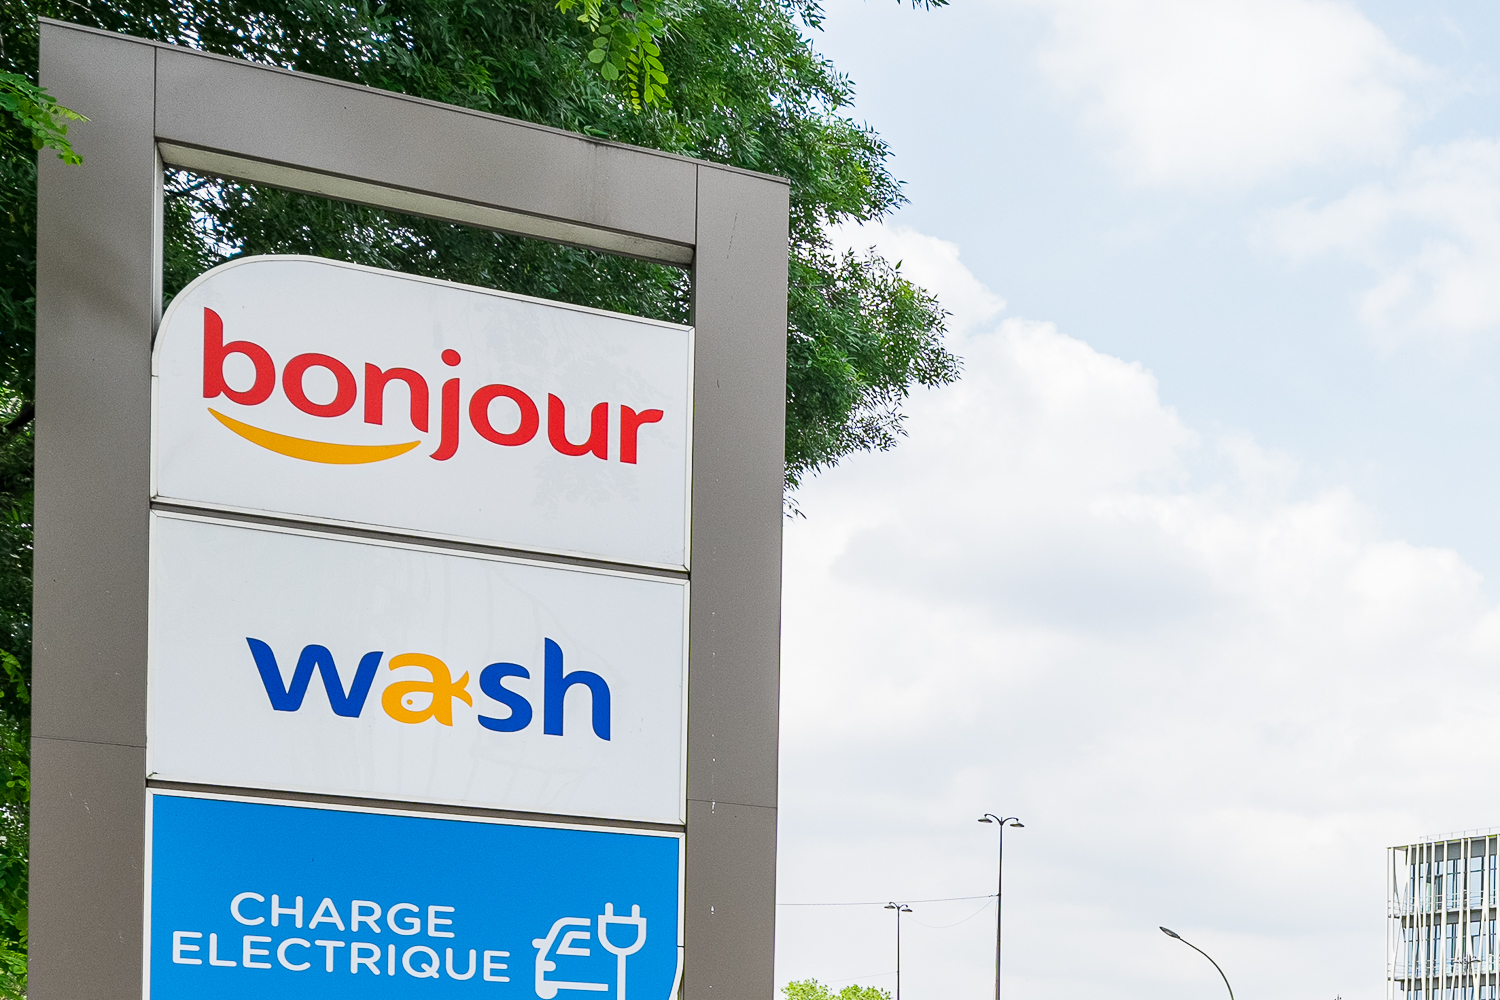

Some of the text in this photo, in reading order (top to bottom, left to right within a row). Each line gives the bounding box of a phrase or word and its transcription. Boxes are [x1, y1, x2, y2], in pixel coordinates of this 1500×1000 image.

[202, 306, 664, 465] bonjour
[246, 637, 611, 741] wash
[230, 891, 456, 940] CHARGE
[172, 931, 511, 983] ELECTRIQUE
